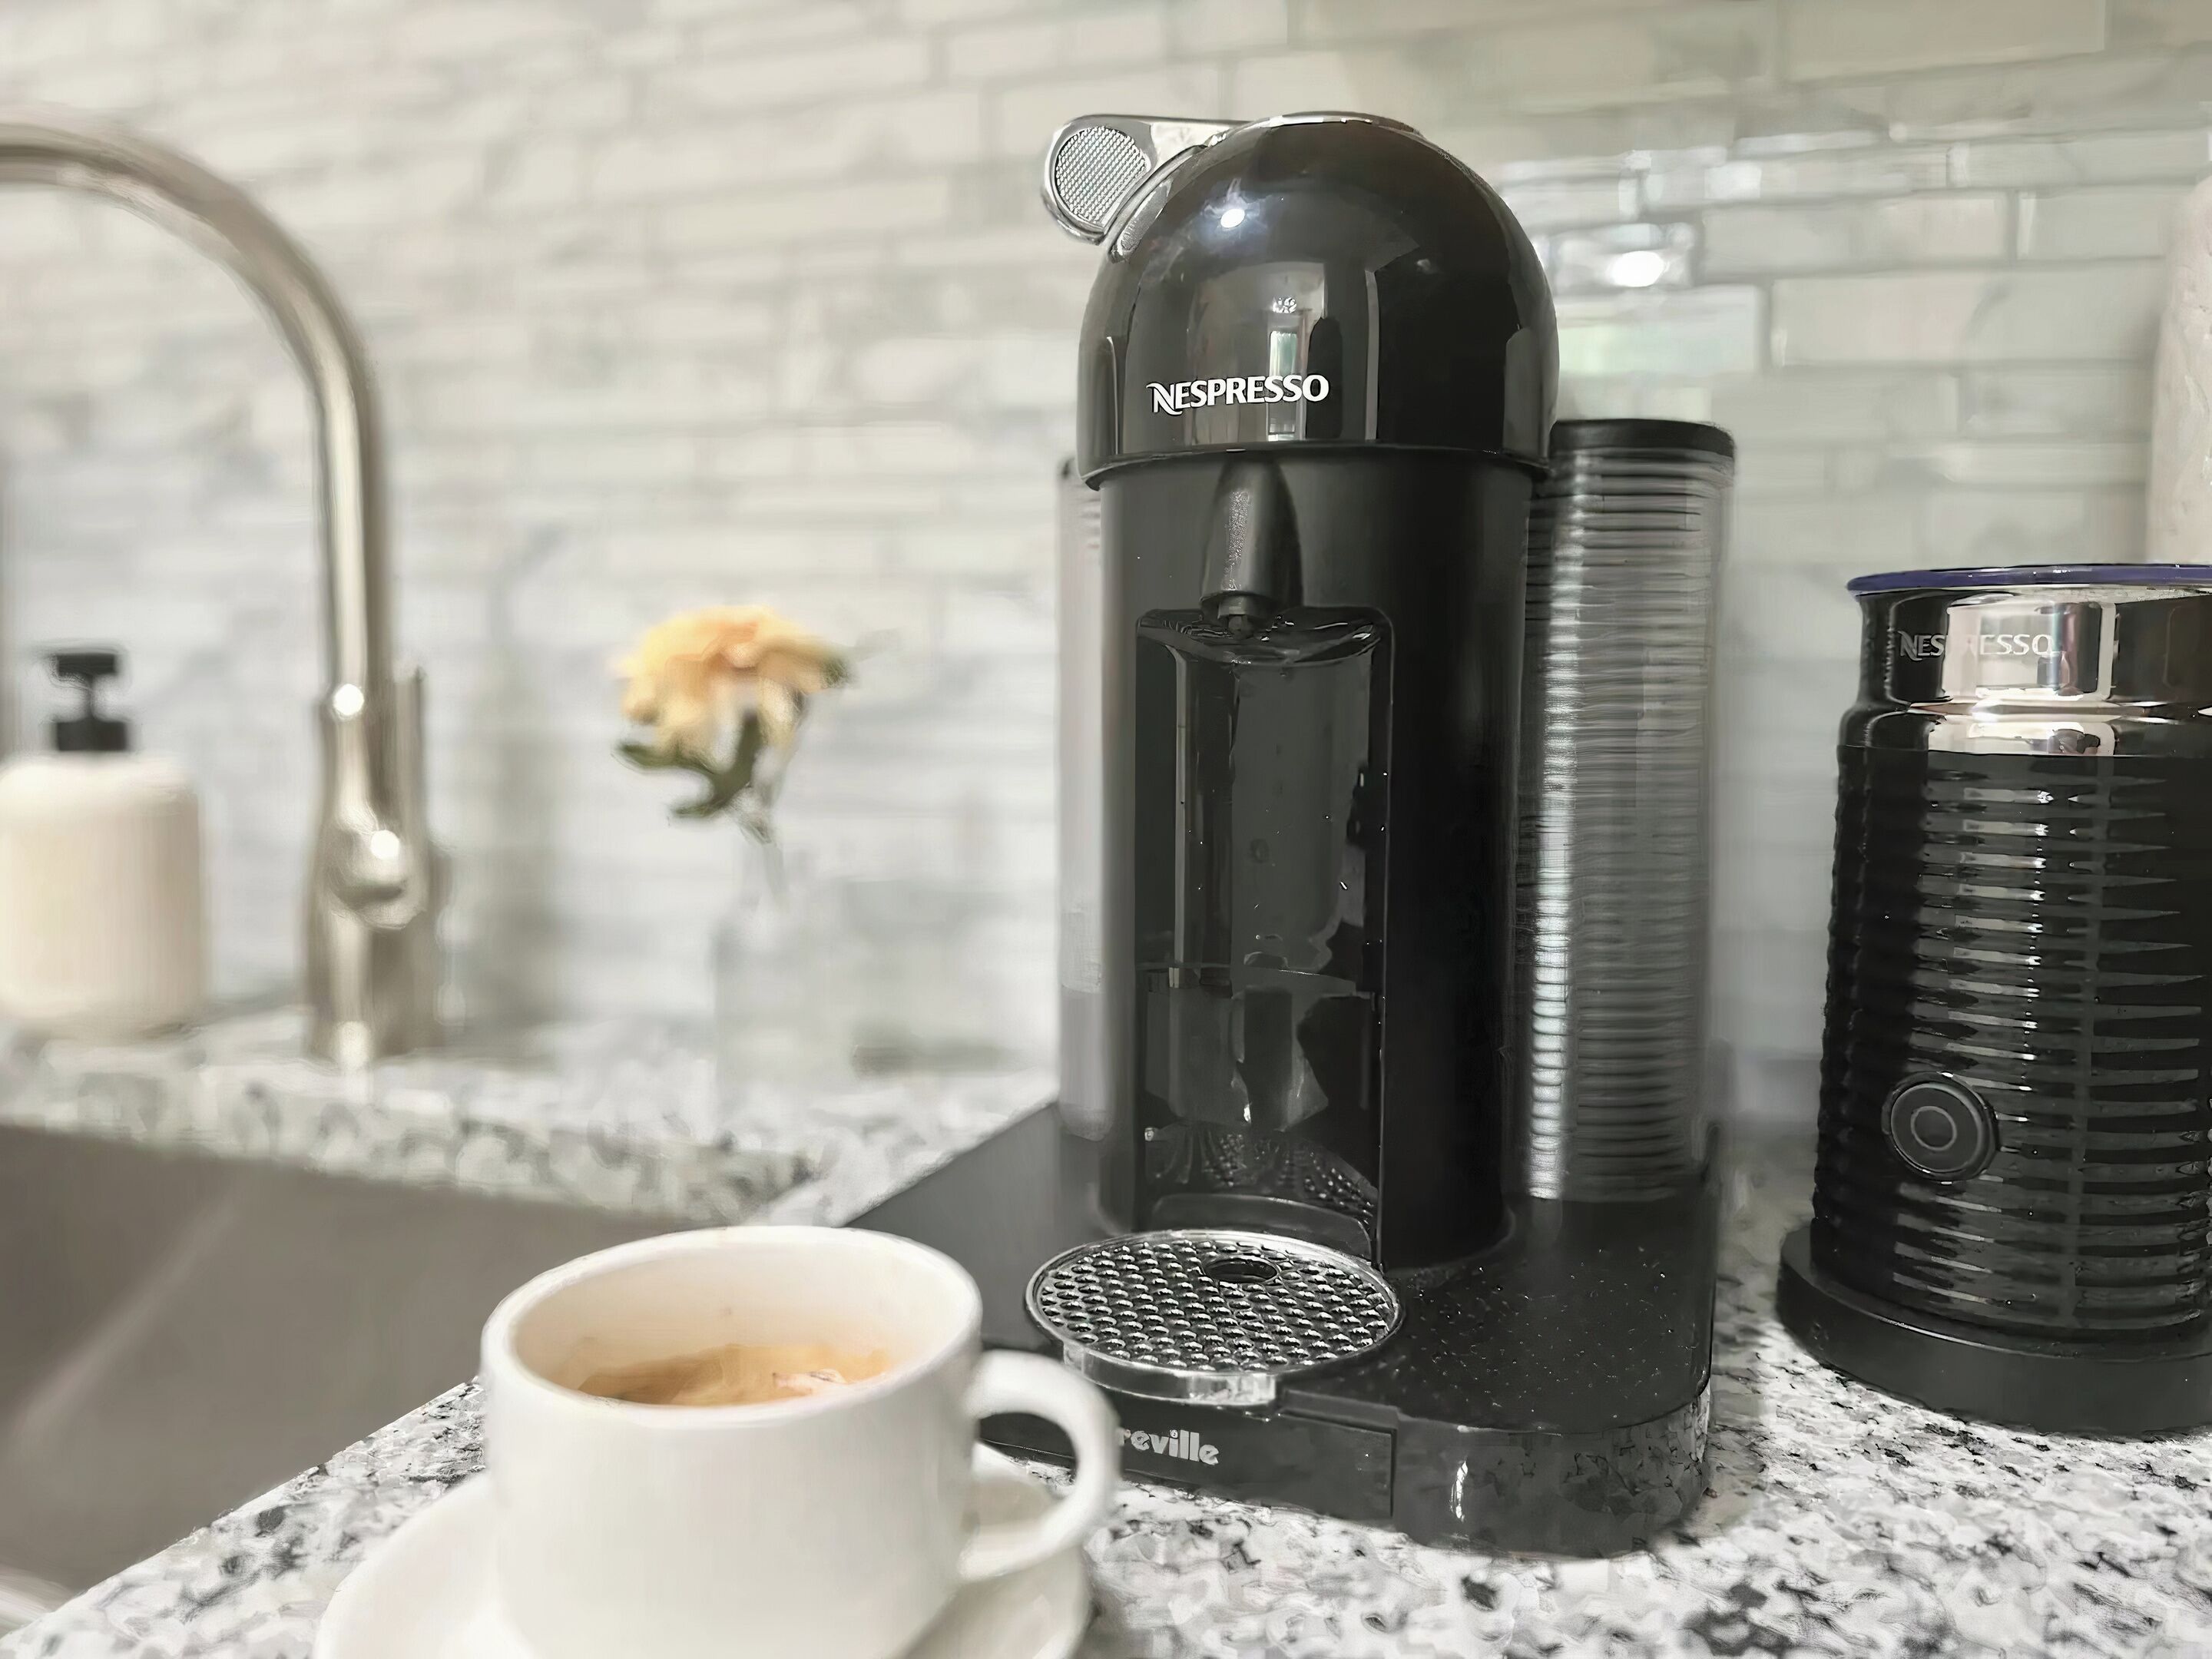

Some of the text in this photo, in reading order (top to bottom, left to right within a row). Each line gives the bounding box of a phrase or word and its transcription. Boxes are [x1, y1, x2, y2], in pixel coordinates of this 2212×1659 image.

[1146, 373, 1330, 416] NESPRESSO
[1897, 630, 2055, 661] NESESSO
[1117, 1426, 1220, 1465] reville
